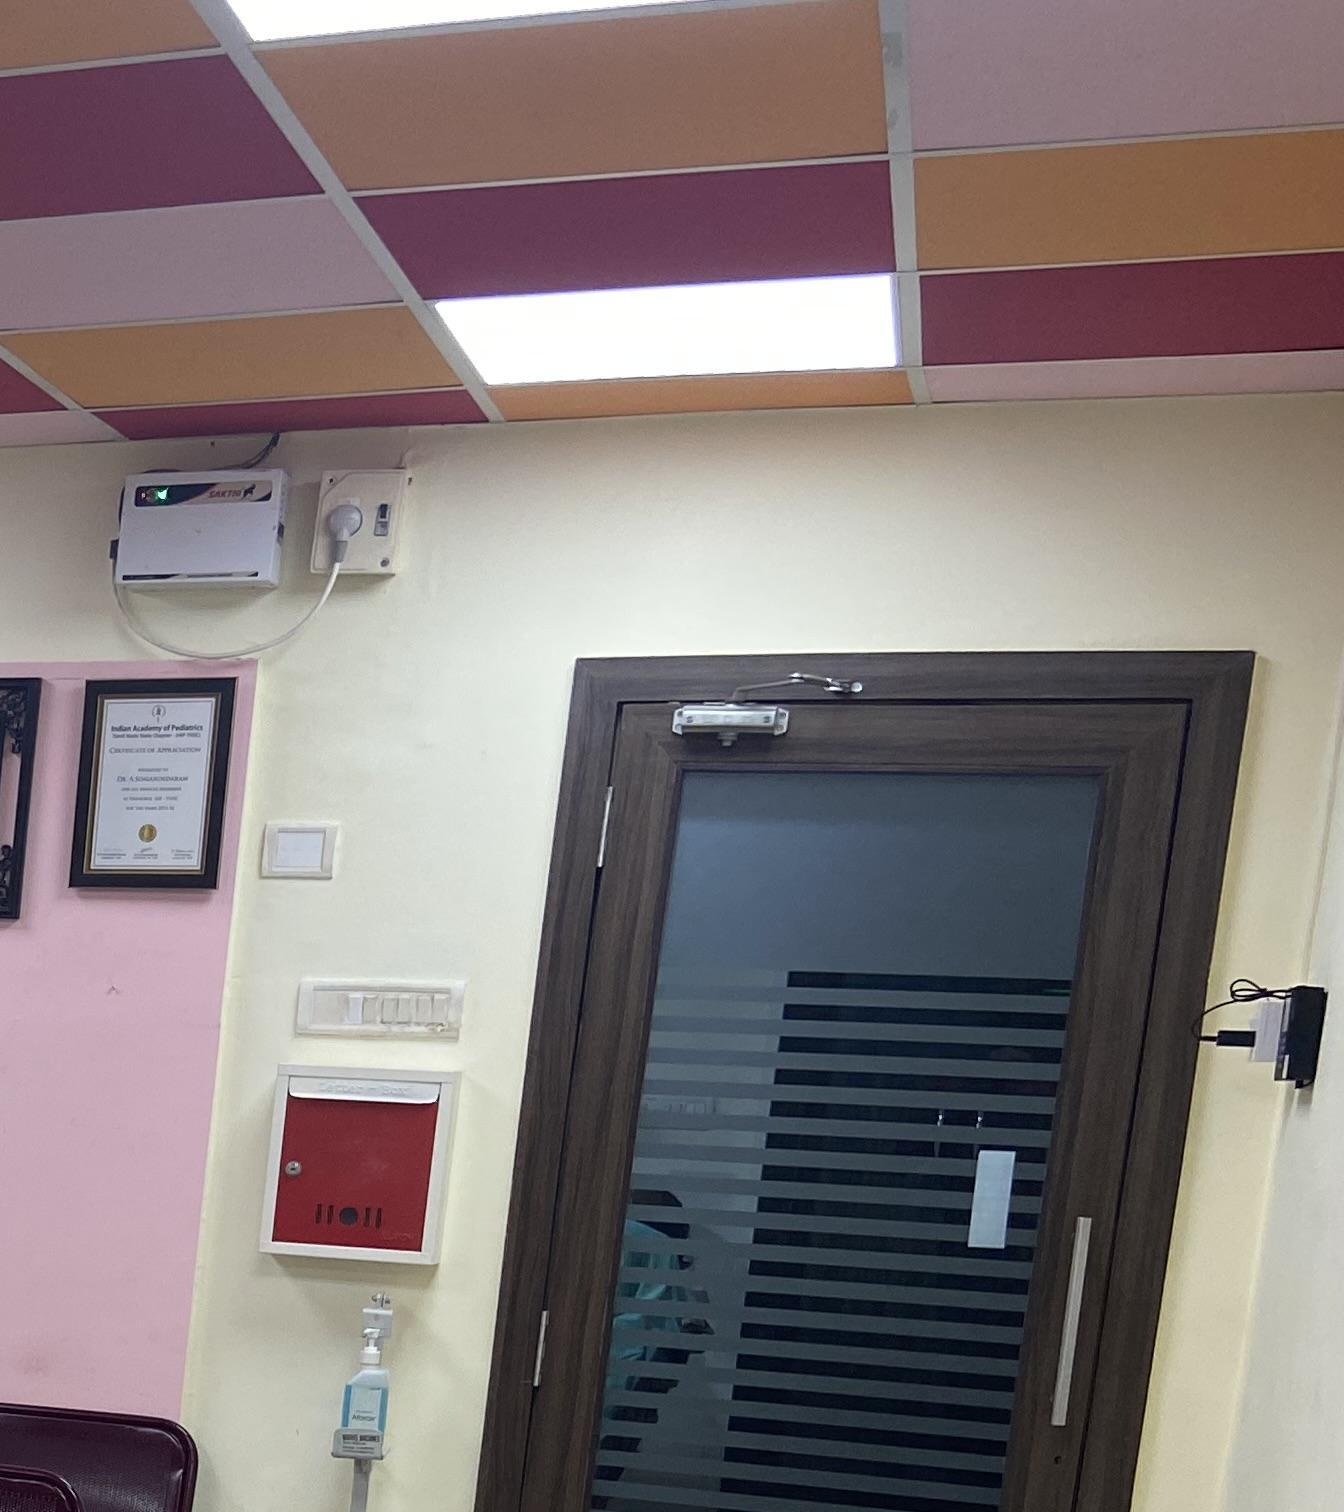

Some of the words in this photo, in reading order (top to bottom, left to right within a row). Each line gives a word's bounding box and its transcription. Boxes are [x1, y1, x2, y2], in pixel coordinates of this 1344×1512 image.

[111, 724, 132, 732] Indian
[133, 724, 161, 733] Academy
[171, 724, 203, 732] Pediatrics
